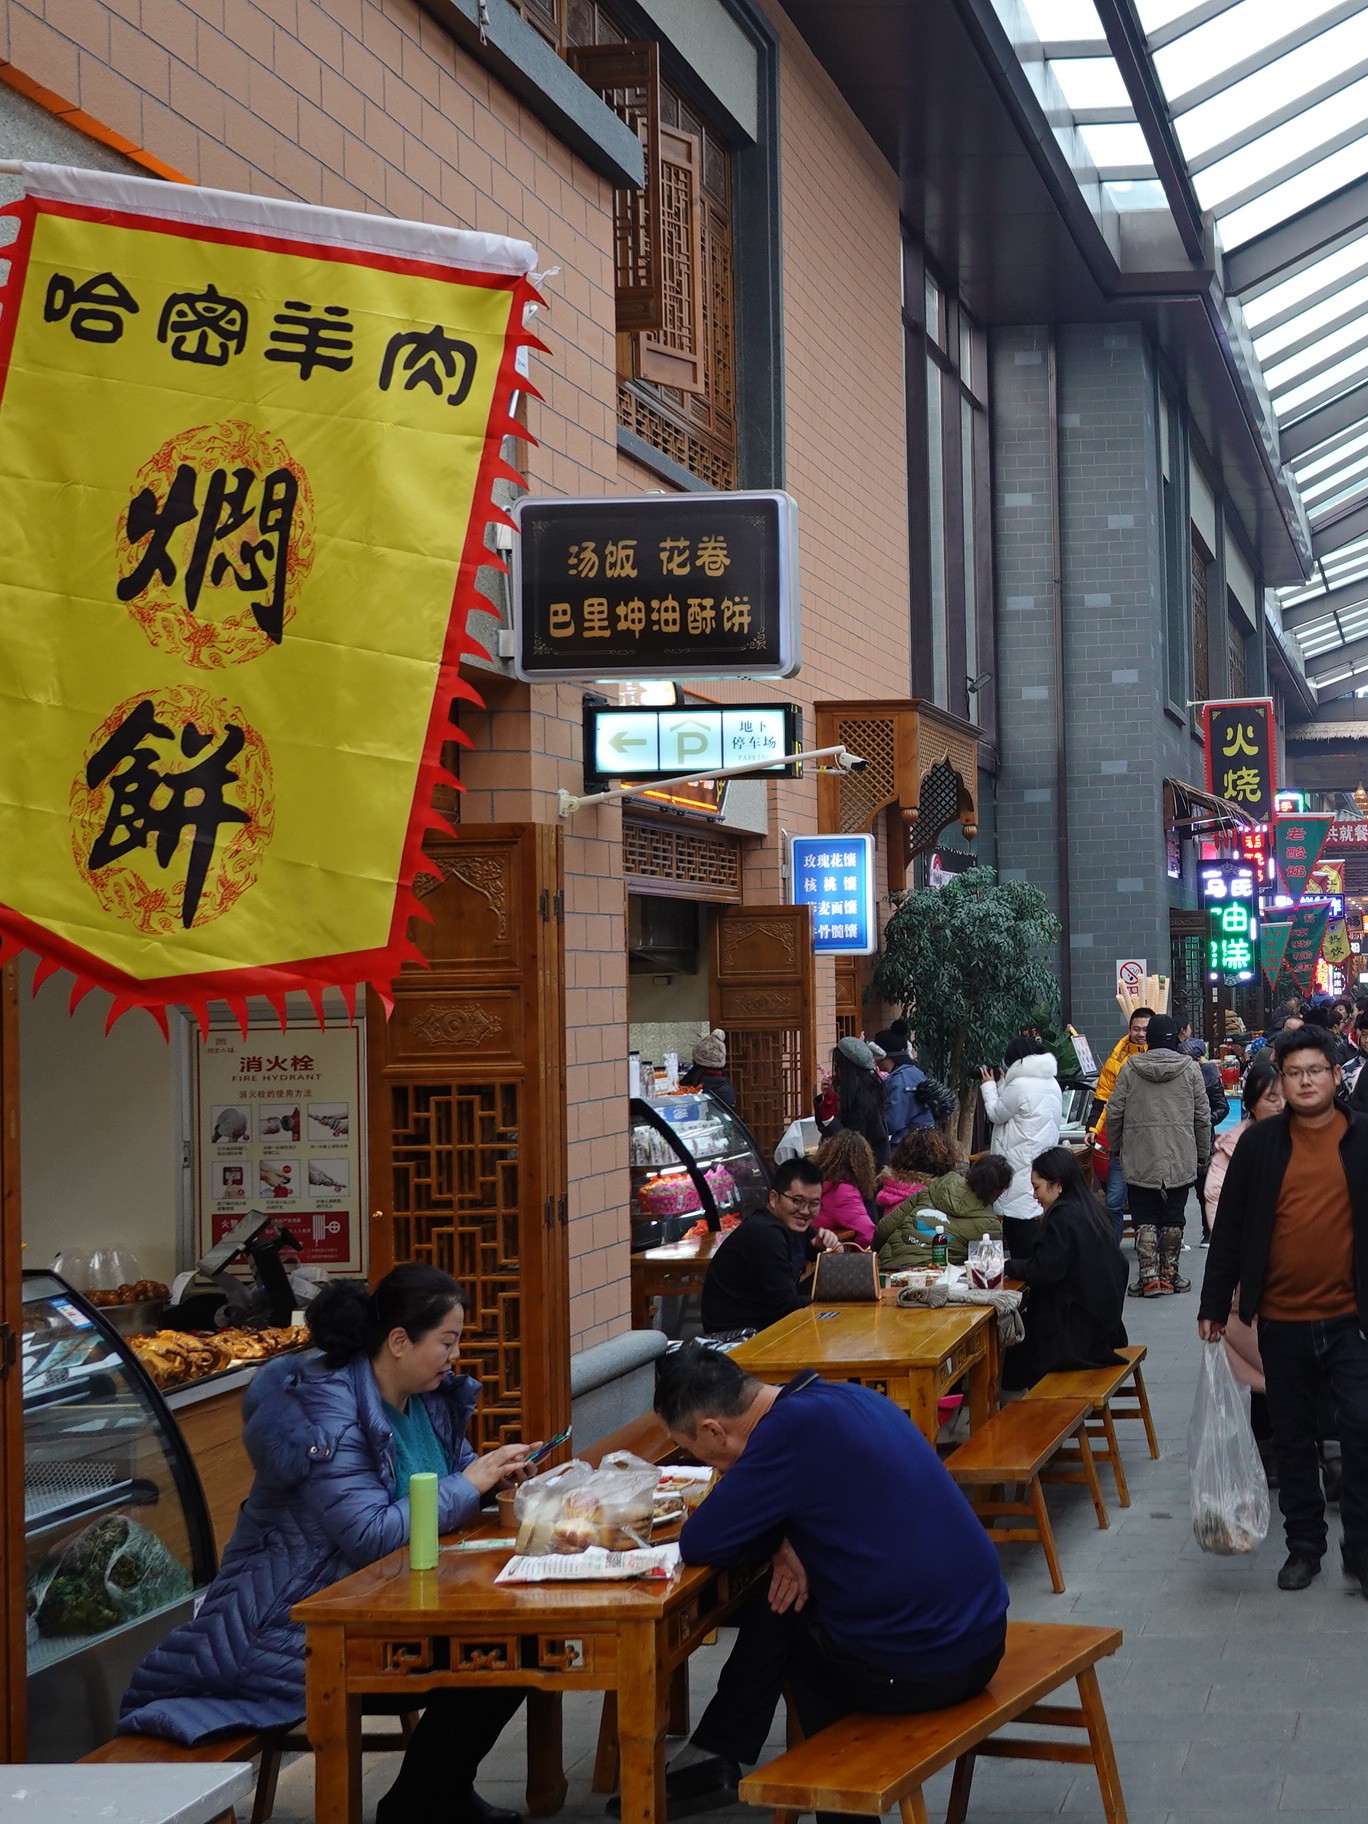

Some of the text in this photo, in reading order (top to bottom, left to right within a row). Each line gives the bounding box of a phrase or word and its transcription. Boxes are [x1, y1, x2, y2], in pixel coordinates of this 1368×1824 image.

[43, 271, 479, 406] 哈密羊肉
[568, 536, 732, 578] 汤饭 花卷
[548, 595, 752, 641] 巴里坤油酥饼
[740, 720, 767, 733] 地下
[677, 733, 708, 765] P
[732, 735, 776, 750] 停车场
[1222, 723, 1261, 803] 火烧
[803, 852, 857, 868] 玫瑰花馕
[1285, 828, 1307, 878] 老酸奶
[803, 876, 857, 893] 核桃馕
[814, 924, 858, 940] 骨髓馕
[239, 1055, 315, 1073] 消火栓
[232, 1073, 323, 1083] FIRE HYDRANT
